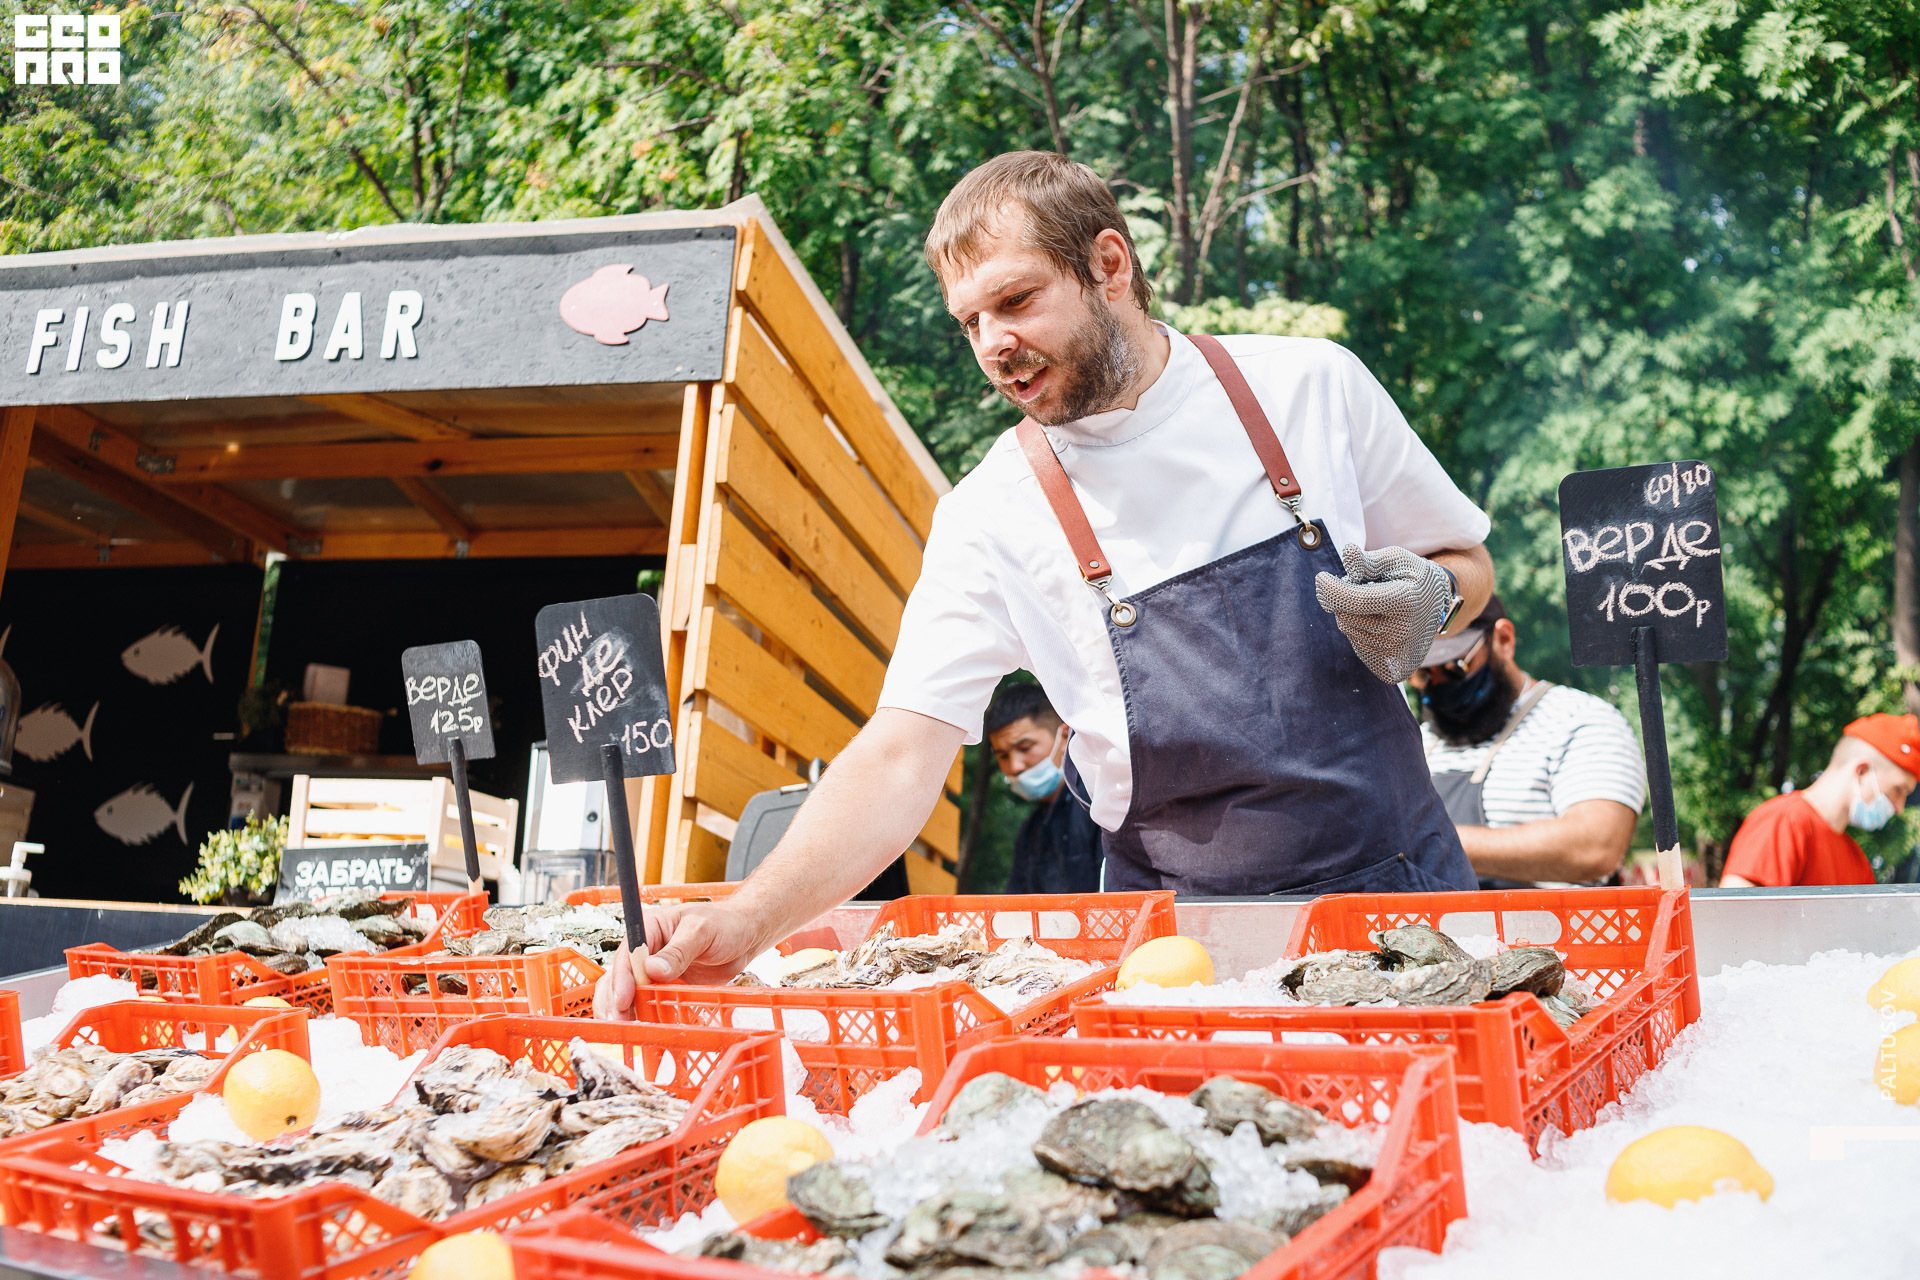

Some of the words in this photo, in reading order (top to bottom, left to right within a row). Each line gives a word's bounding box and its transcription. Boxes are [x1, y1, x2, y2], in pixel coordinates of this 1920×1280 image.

[26, 300, 189, 374] FISH
[274, 290, 424, 361] BAR
[1645, 462, 1712, 508] 60/80
[1597, 582, 1712, 628] 100р
[430, 706, 484, 735] 125р
[620, 718, 673, 756] 150
[294, 857, 414, 888] ЗАБРАТЬ
